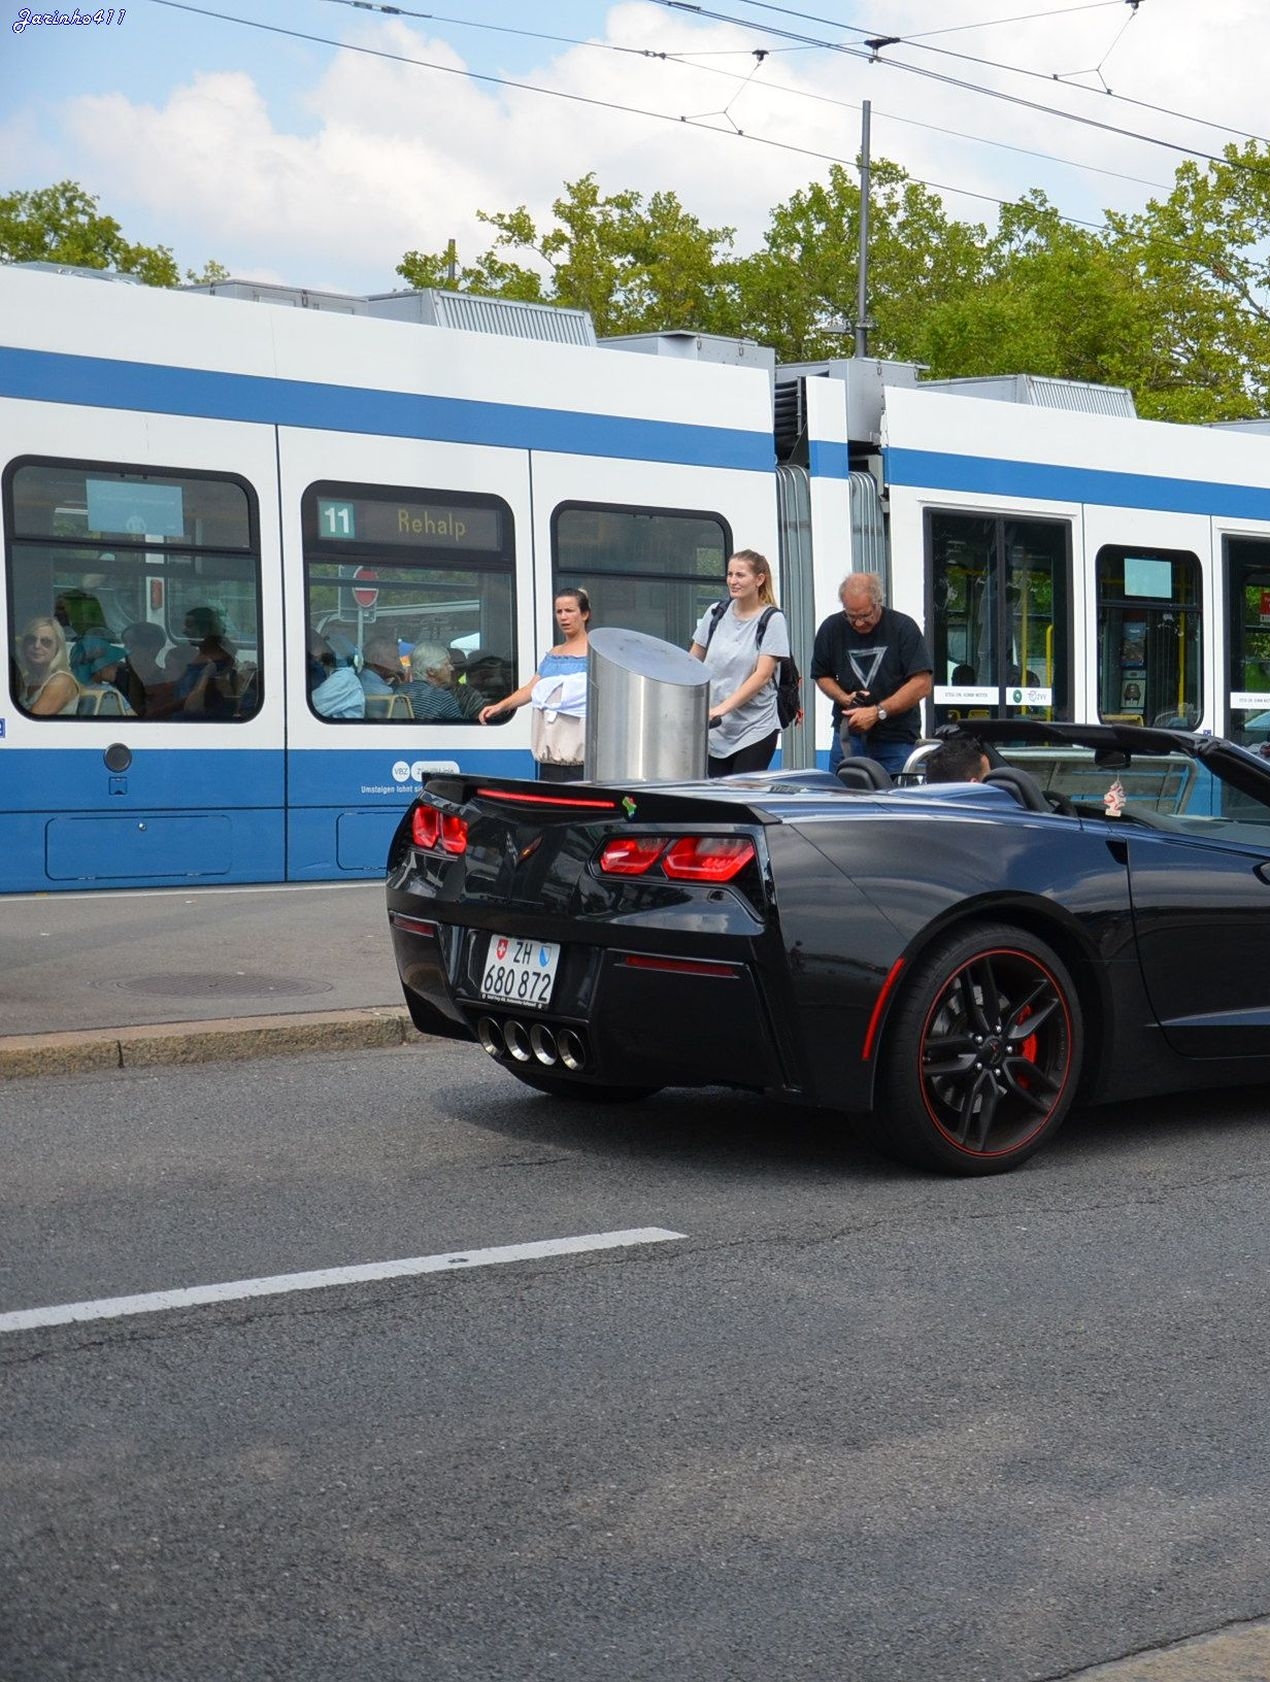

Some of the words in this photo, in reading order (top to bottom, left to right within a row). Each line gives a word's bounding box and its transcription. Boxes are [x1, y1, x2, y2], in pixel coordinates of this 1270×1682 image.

[324, 507, 350, 534] 11
[398, 508, 467, 542] Rehalp
[361, 785, 395, 795] Umsteigen
[396, 785, 413, 793] lohnt
[513, 941, 533, 965] ZH
[484, 964, 515, 996] 680
[517, 970, 552, 1002] 872
